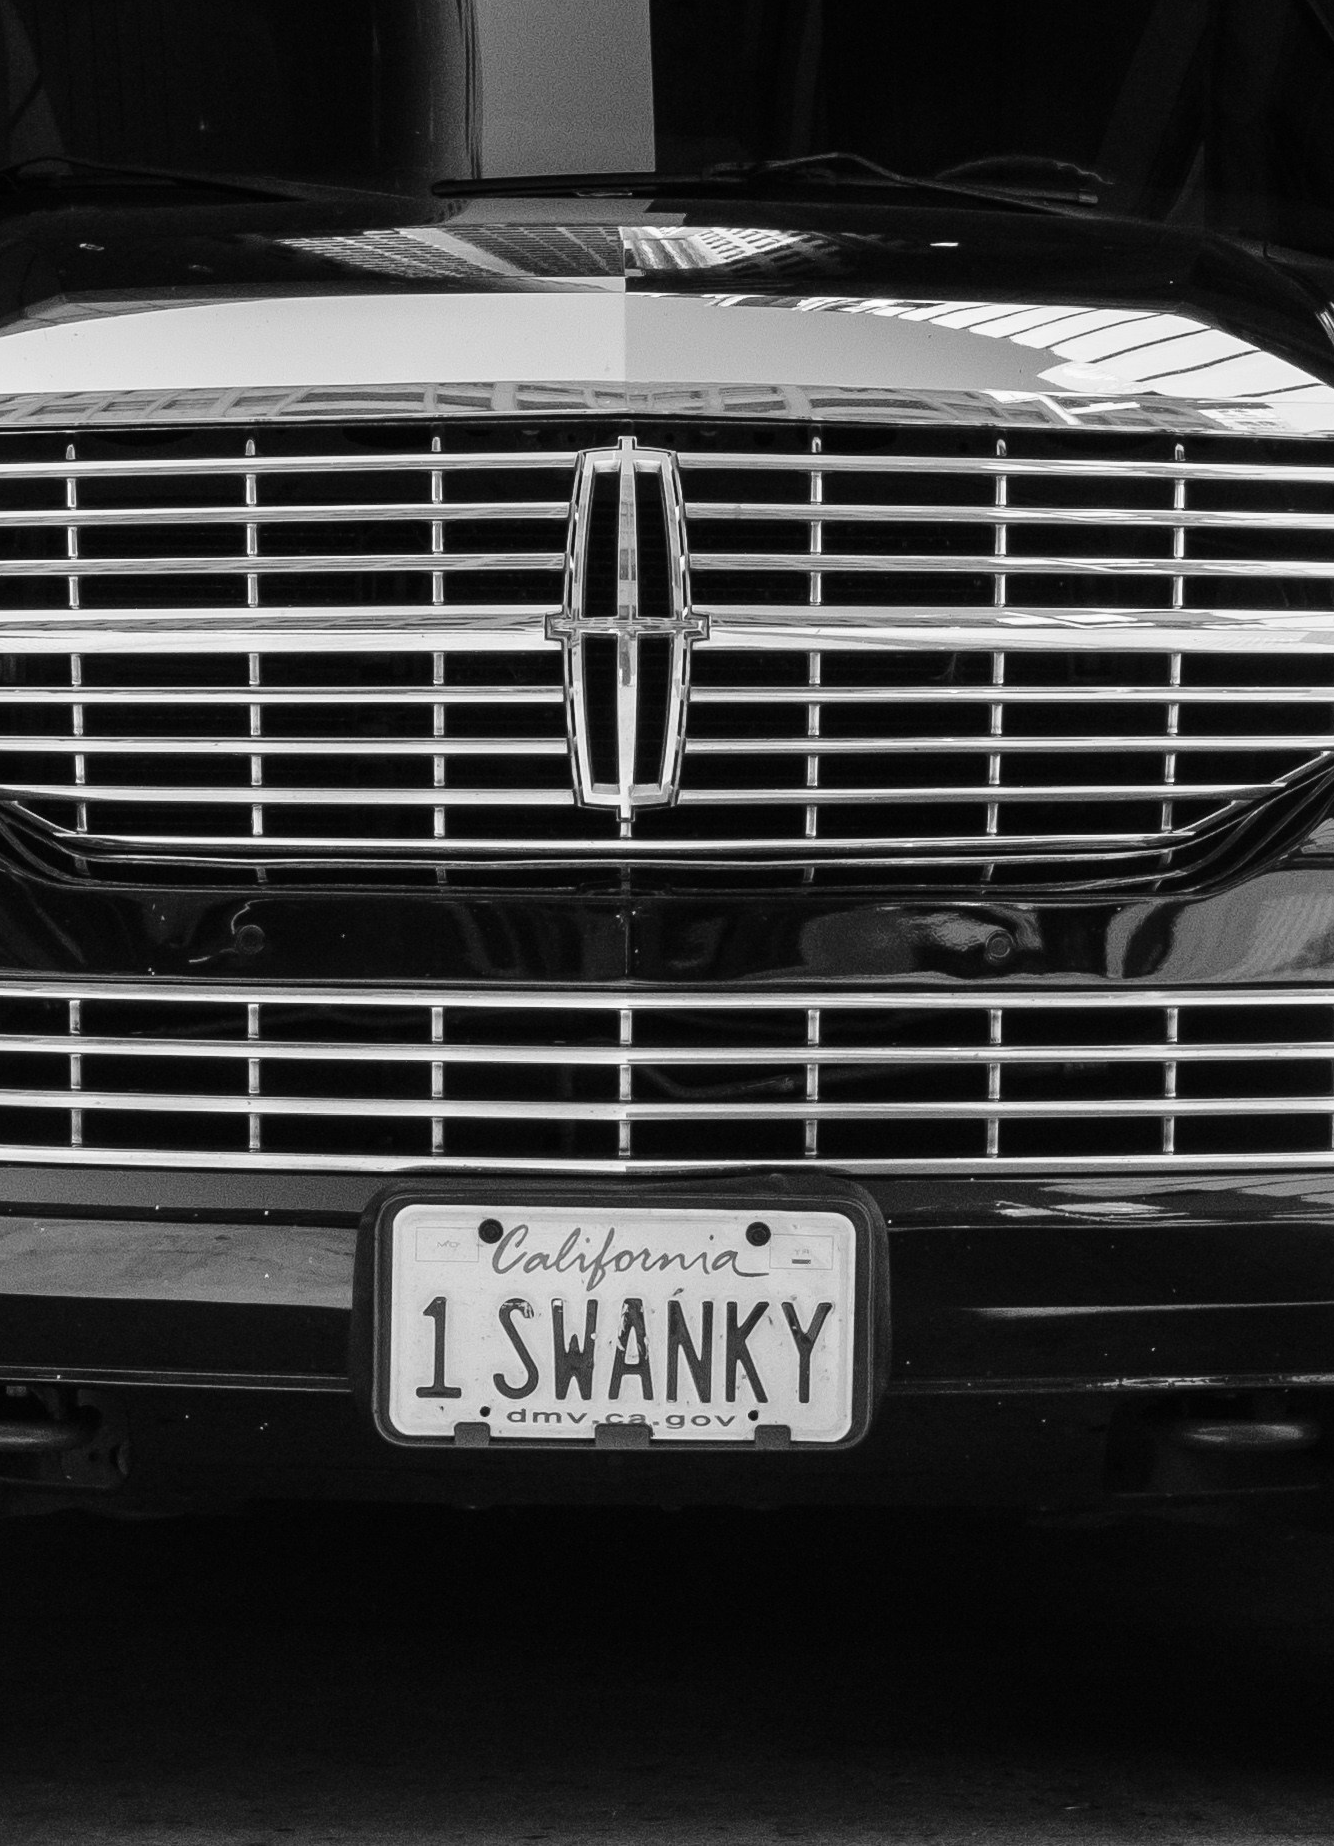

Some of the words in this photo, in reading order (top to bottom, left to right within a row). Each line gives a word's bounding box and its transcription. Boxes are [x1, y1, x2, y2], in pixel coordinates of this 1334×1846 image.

[492, 1223, 770, 1292] California
[493, 1297, 834, 1404] SWANKY
[506, 1408, 736, 1429] dmv.ca.gov
